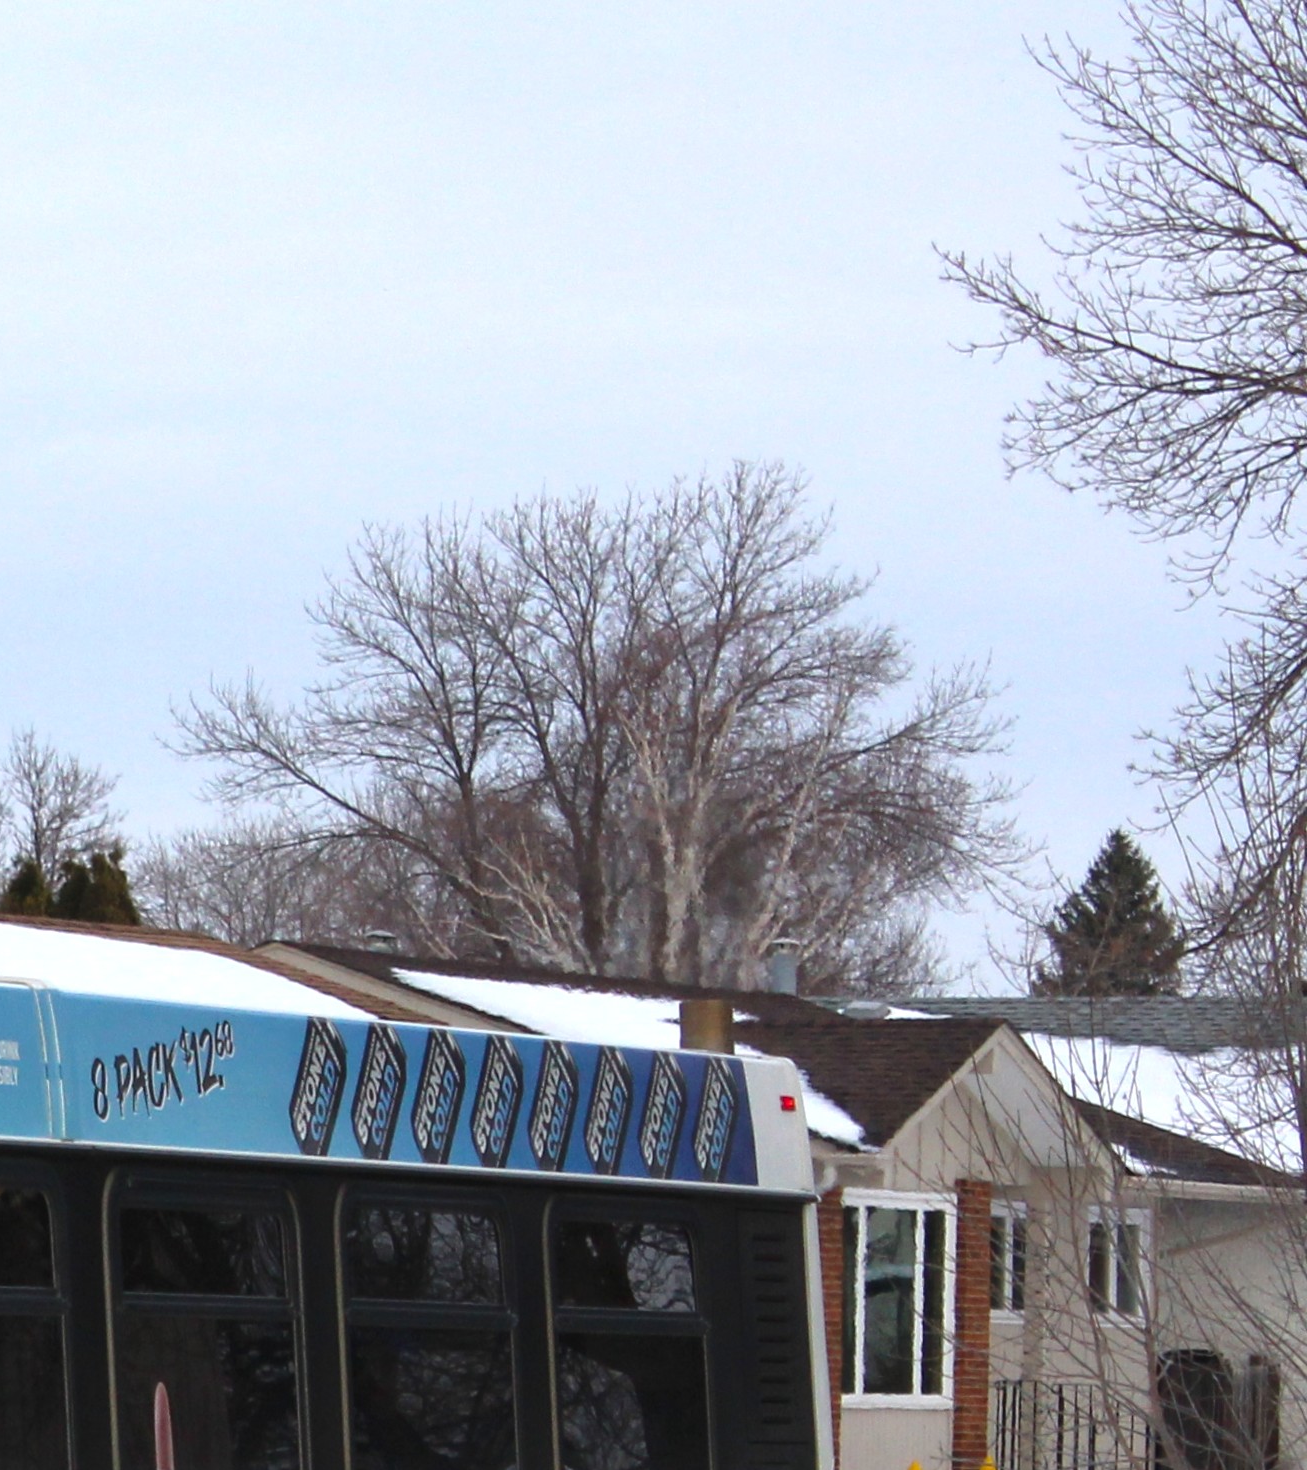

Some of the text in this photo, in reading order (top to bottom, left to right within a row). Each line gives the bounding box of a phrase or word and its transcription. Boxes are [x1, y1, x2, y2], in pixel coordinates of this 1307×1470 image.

[91, 1057, 110, 1122] 8
[114, 1038, 185, 1119] PACK
[296, 1034, 327, 1141] STONE
[311, 1060, 336, 1141] COLD
[357, 1040, 386, 1145] STONE
[372, 1064, 395, 1146] COLD
[417, 1045, 446, 1149] STONE
[431, 1069, 454, 1150] COLD
[476, 1051, 504, 1154] STONE
[490, 1075, 513, 1154] COLD
[534, 1058, 561, 1158] STONE
[547, 1080, 569, 1159] COLD
[590, 1062, 615, 1162] STONE
[644, 1067, 669, 1167] STONE
[698, 1072, 722, 1170] STONE
[602, 1085, 623, 1163] COLD
[656, 1090, 677, 1167] COLD
[710, 1094, 730, 1170] COLD
